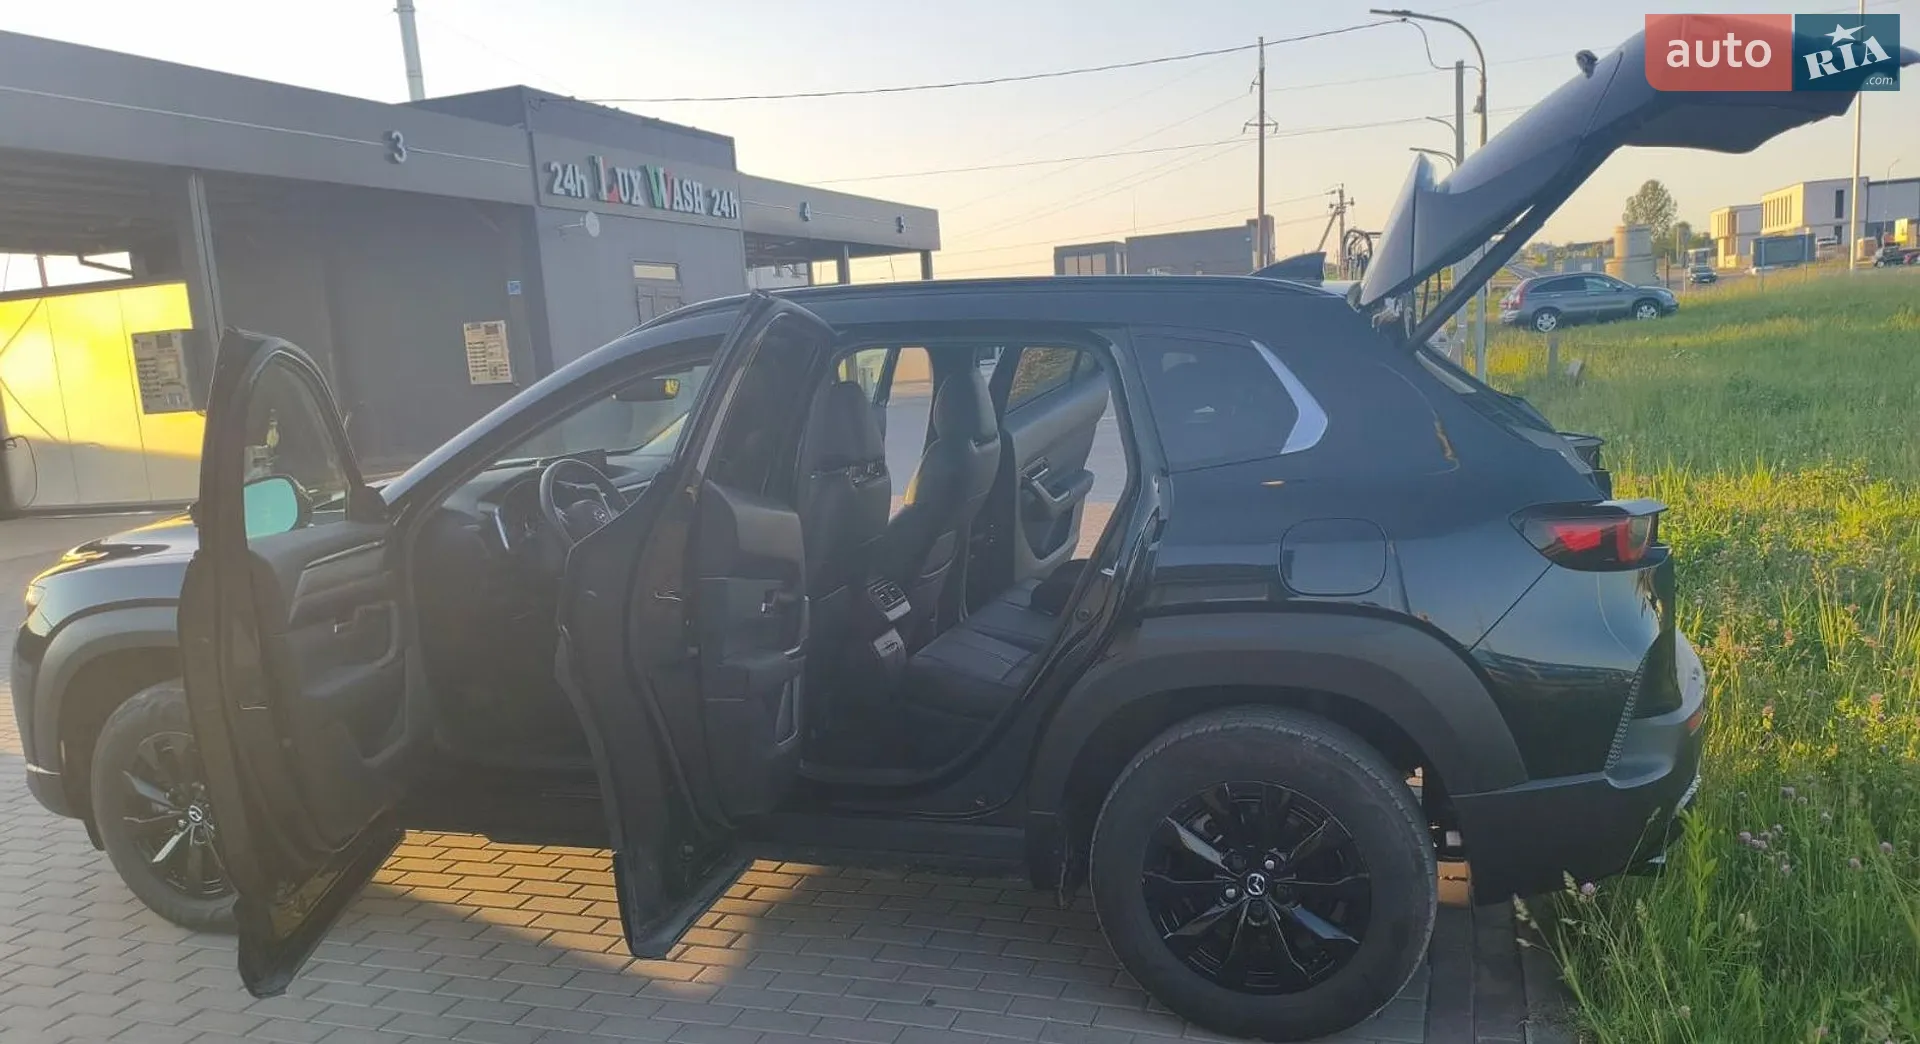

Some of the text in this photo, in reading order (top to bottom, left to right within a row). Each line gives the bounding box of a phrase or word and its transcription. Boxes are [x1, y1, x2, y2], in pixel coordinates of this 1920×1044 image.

[391, 131, 407, 162] 3
[550, 154, 740, 219] 24h LUX WASH 24h
